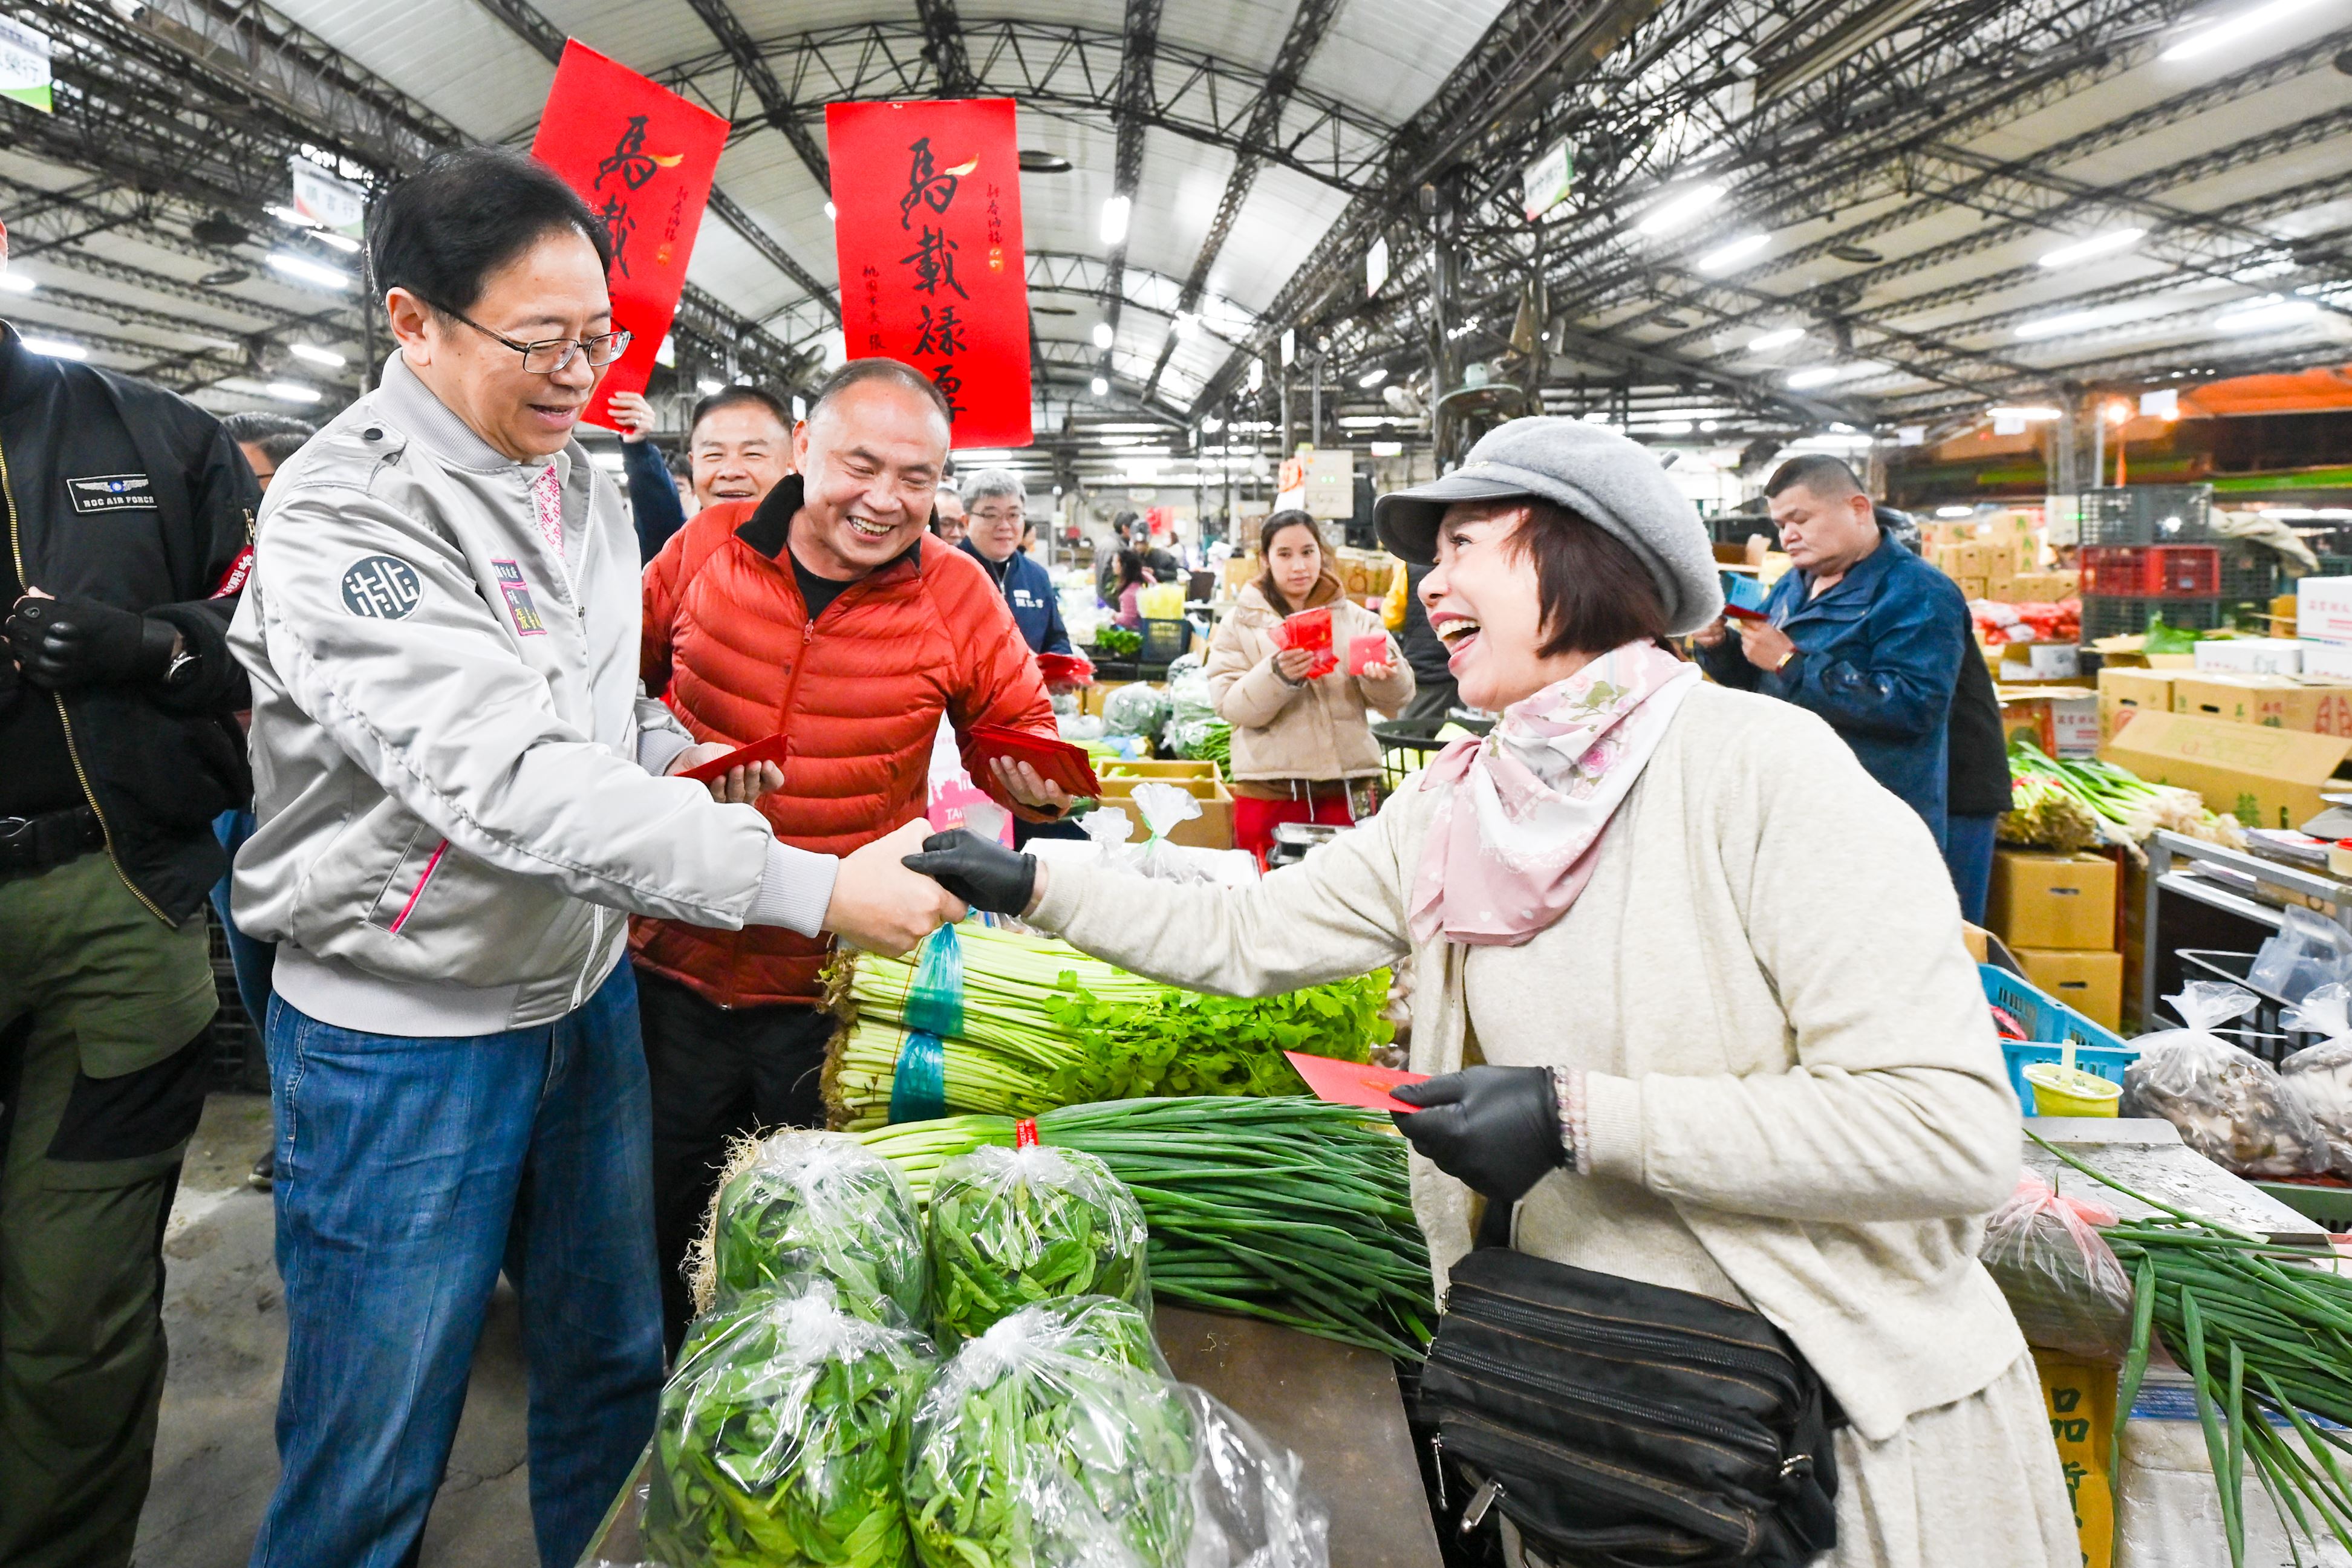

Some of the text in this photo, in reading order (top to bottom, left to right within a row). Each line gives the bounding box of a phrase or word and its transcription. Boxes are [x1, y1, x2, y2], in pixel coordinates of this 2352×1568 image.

[594, 115, 657, 290] 馬載
[83, 498, 105, 507] ROC
[106, 496, 124, 505] AIR
[945, 808, 963, 821] TA
